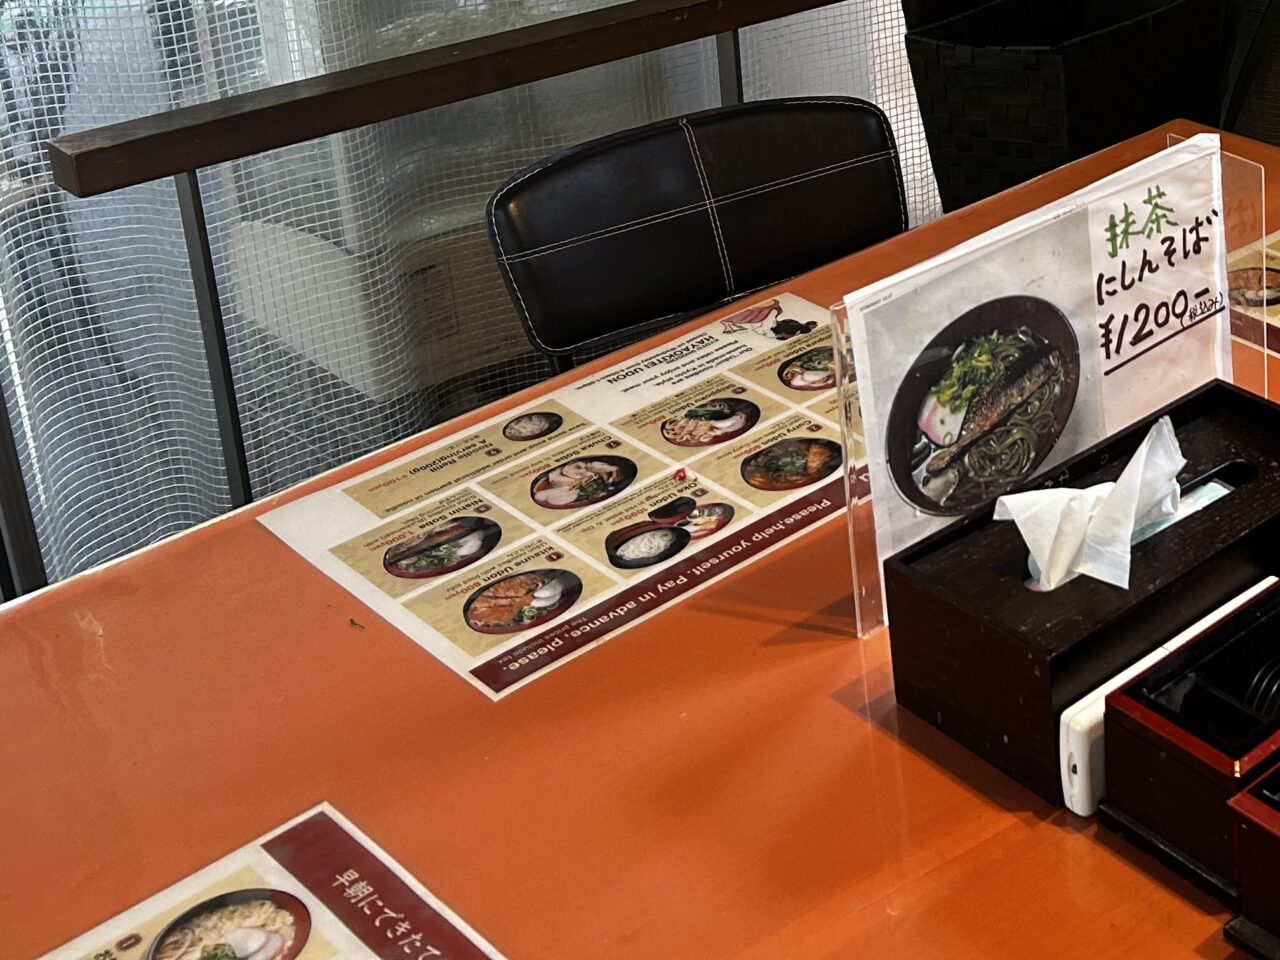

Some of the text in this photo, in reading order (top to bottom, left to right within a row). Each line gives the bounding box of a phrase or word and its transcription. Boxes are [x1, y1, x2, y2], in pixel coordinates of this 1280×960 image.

[1106, 185, 1178, 257] 抹茶
[1097, 210, 1219, 305] にしんそば
[606, 335, 715, 384] HAYAOKITEI UDON
[668, 402, 694, 415] Udon
[784, 418, 812, 434] Curry
[579, 434, 612, 451] Chuka
[760, 431, 787, 446] Udon
[553, 449, 580, 463] Soba
[428, 458, 457, 472] Refill
[675, 481, 698, 494] Oke
[447, 497, 484, 516] Nishin
[647, 491, 677, 508] Udon
[417, 514, 448, 530] Soba
[684, 538, 752, 578] yourself.
[481, 565, 513, 583] Udon
[653, 572, 688, 593] Pay
[636, 590, 657, 603] in
[562, 597, 638, 642] advance,
[500, 636, 566, 675] please.
